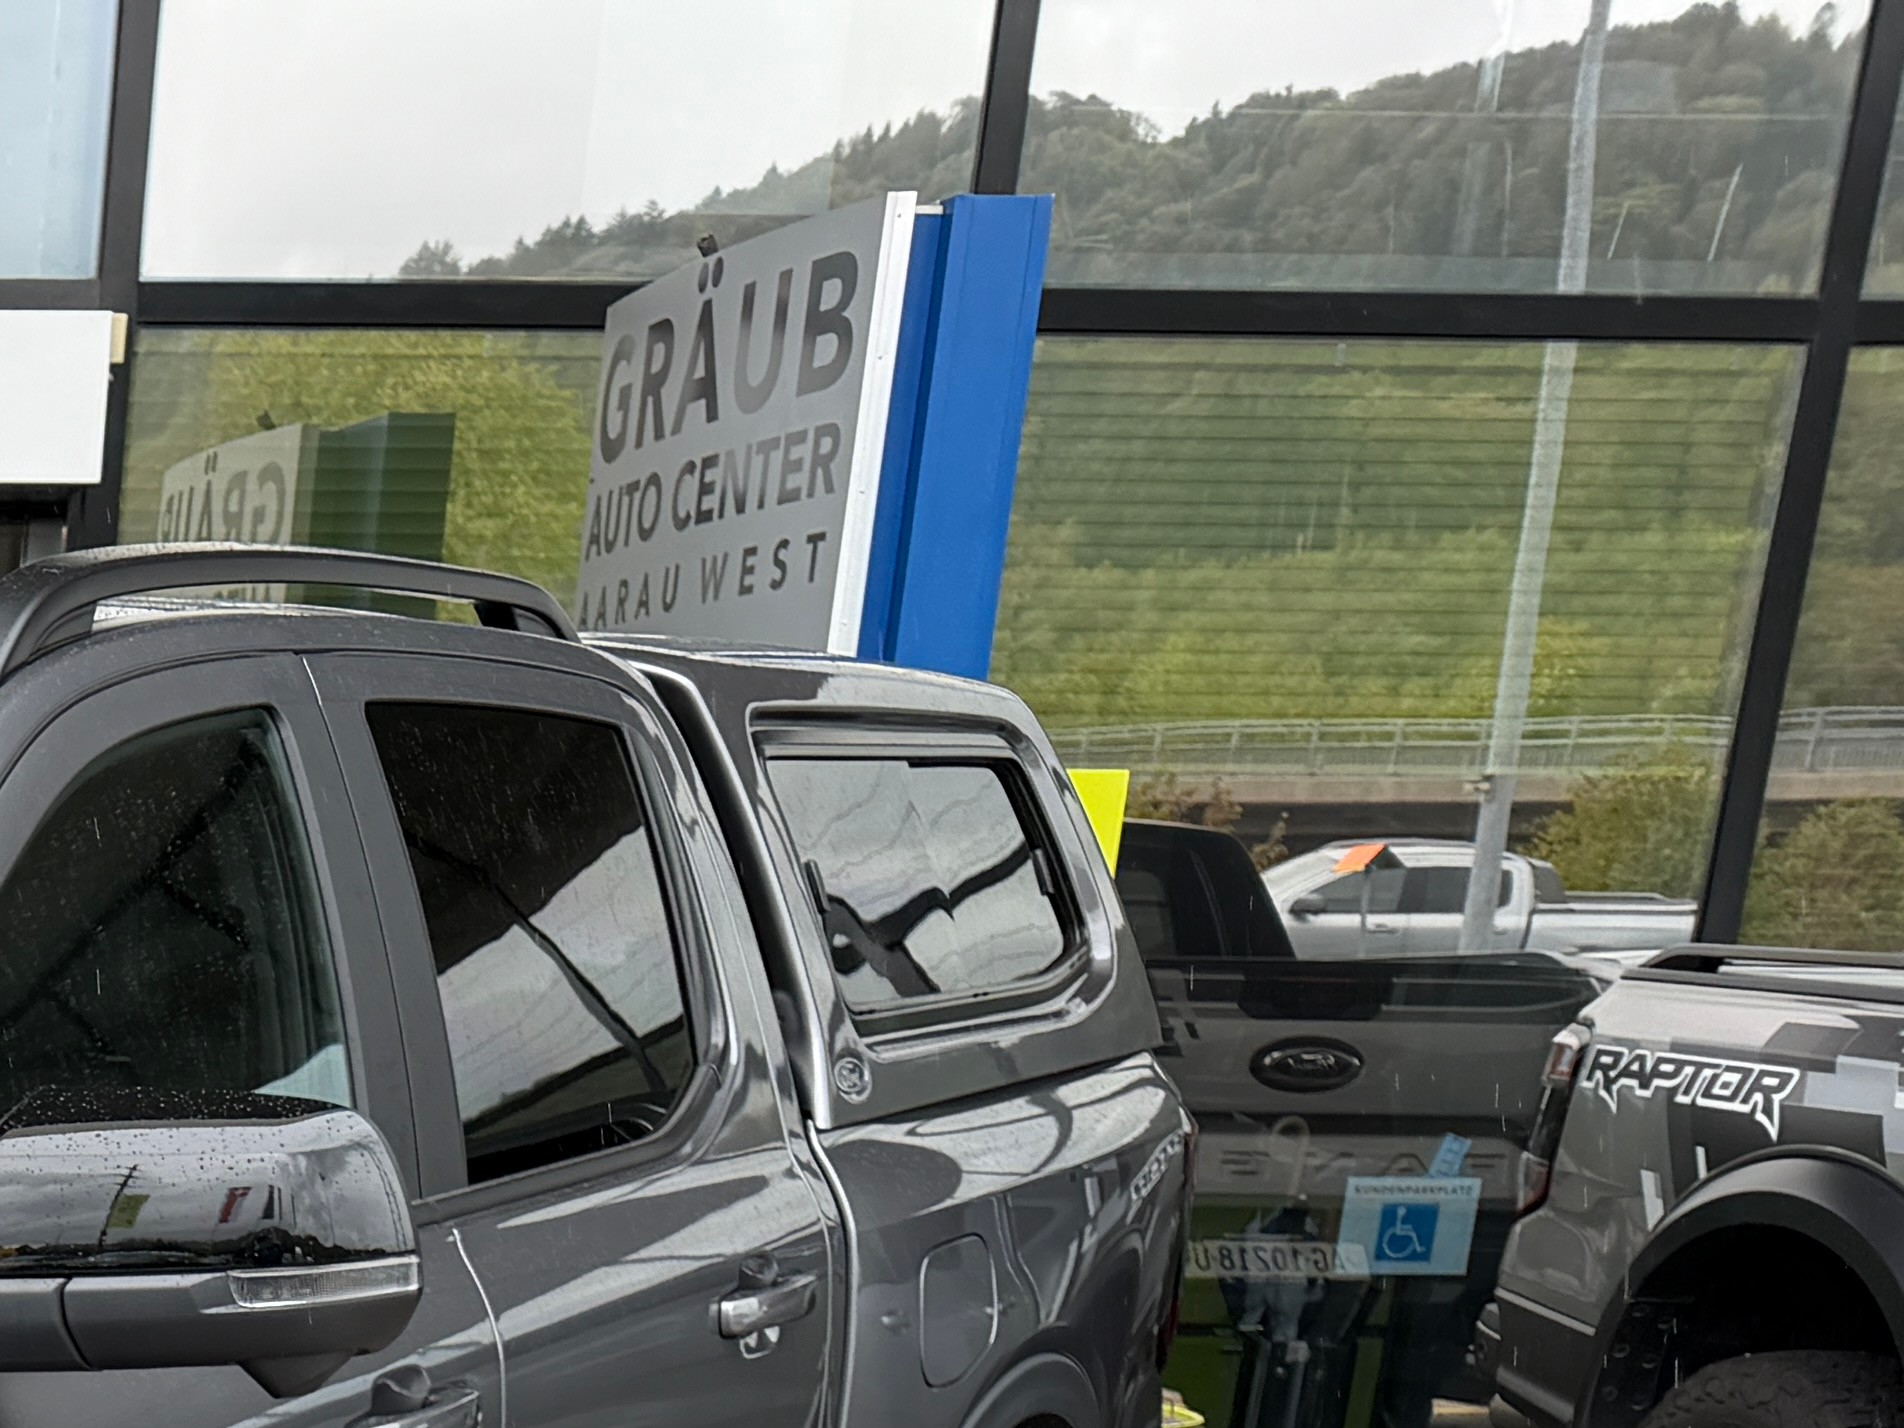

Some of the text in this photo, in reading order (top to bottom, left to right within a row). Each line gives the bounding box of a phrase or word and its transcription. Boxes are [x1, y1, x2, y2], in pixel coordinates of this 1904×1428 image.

[600, 251, 858, 464] GRÄUB
[585, 422, 840, 562] AUTO CENTER
[578, 531, 826, 631] AARAU WEST
[1578, 1045, 1800, 1142] RAPTOR
